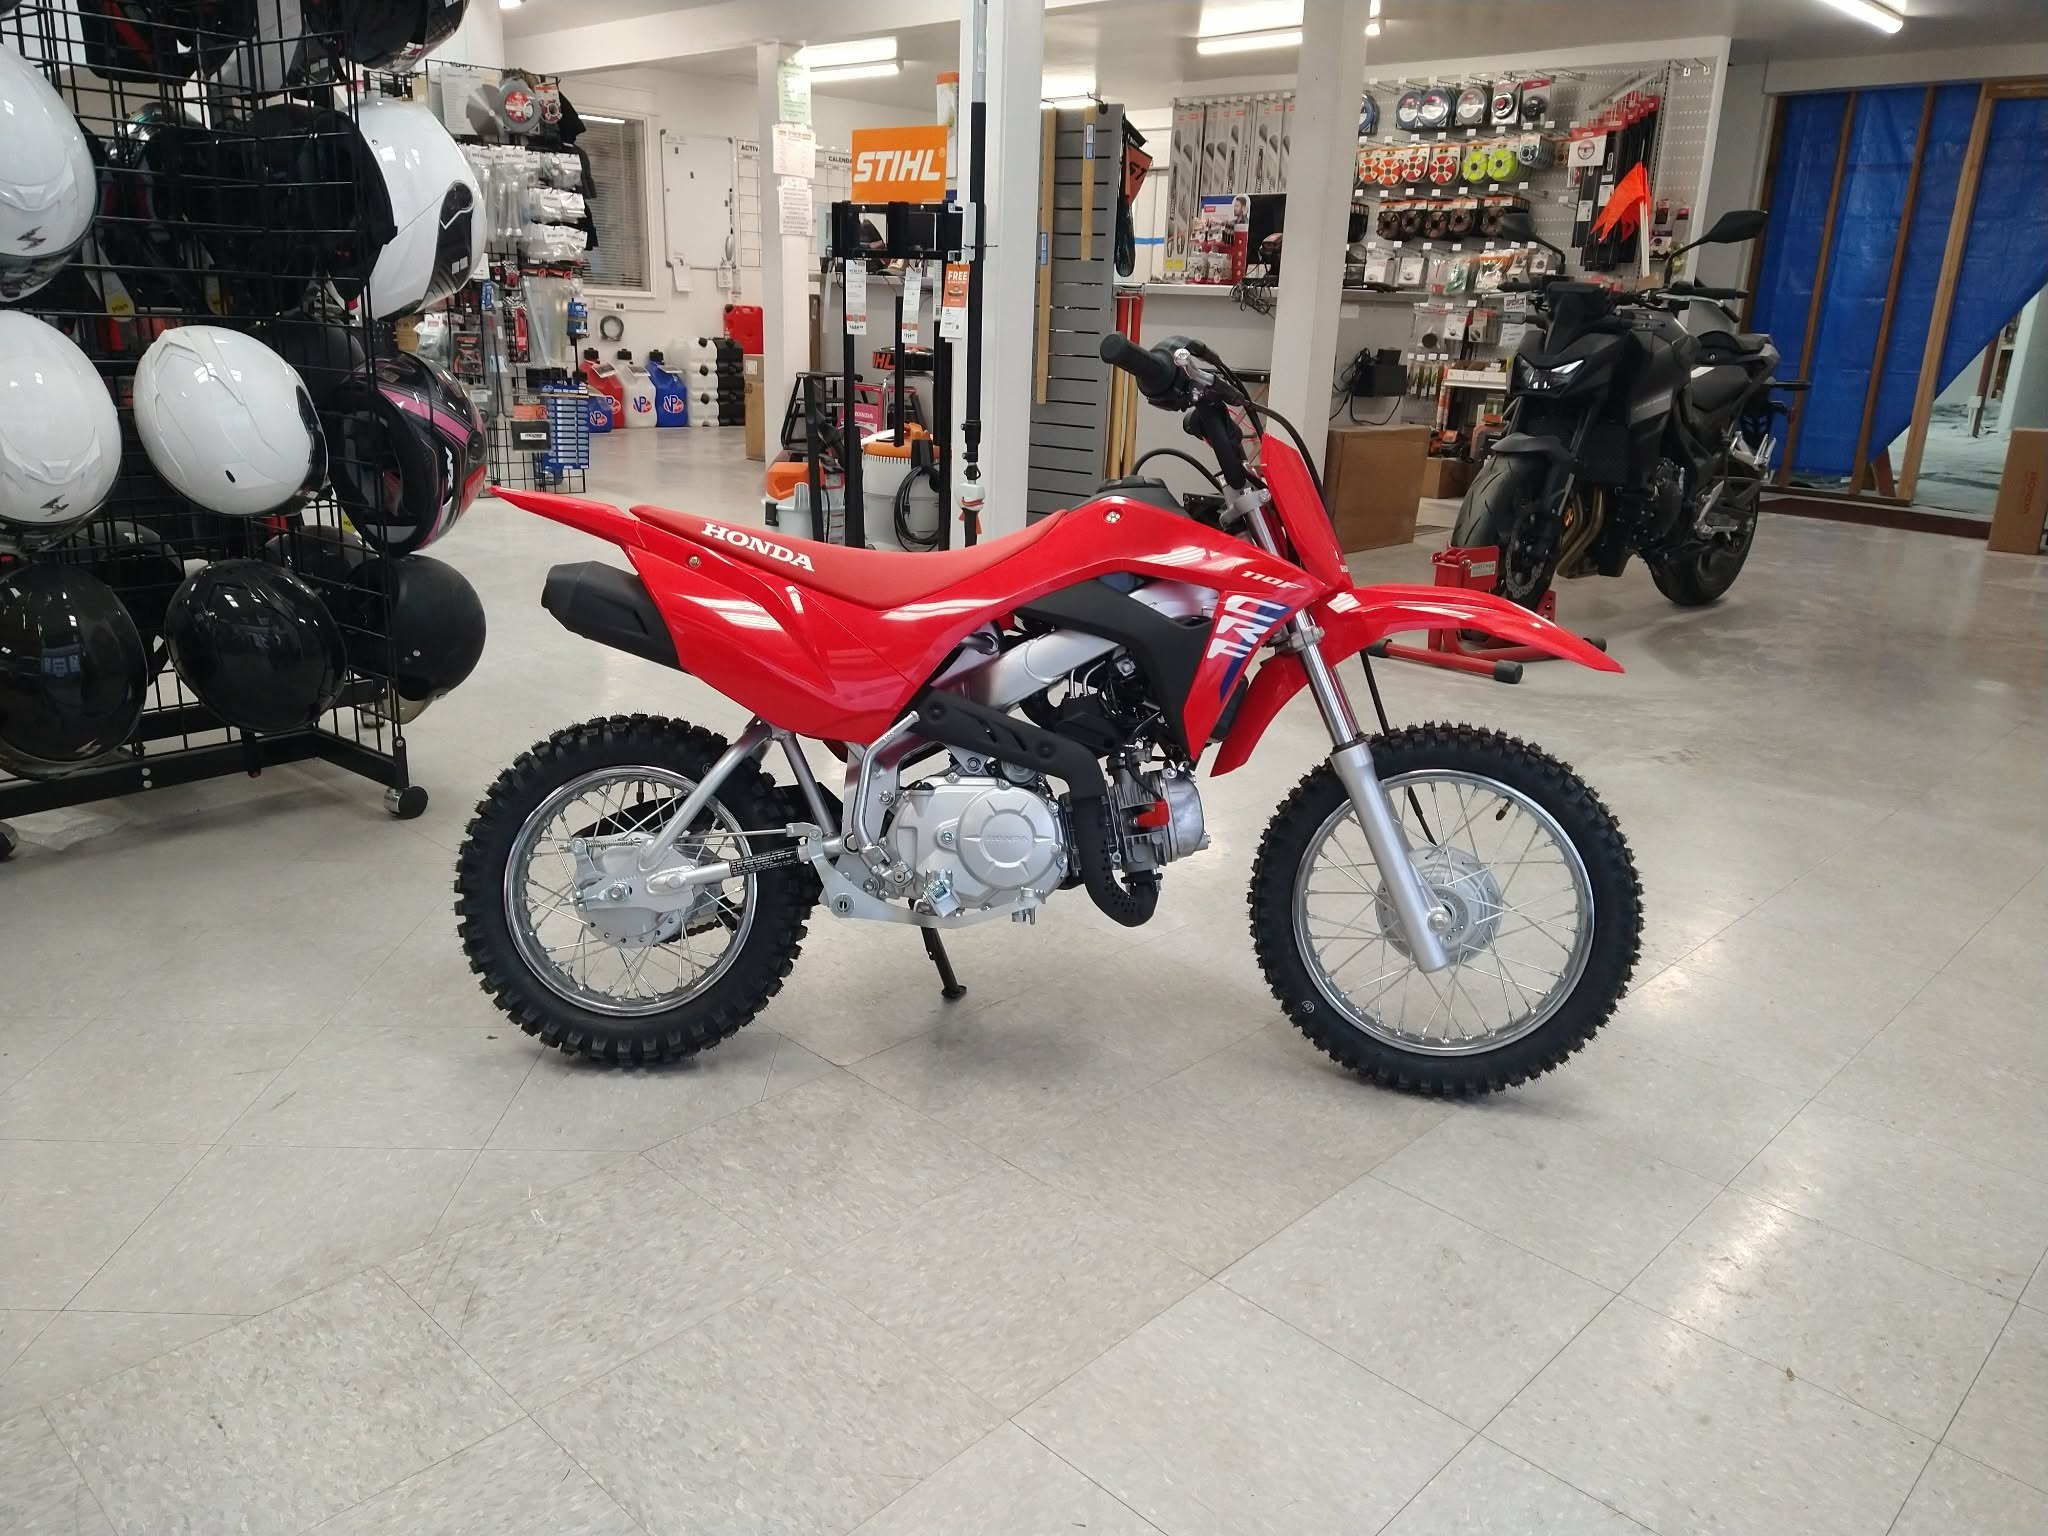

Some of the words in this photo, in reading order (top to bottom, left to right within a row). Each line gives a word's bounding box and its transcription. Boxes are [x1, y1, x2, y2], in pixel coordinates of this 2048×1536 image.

[854, 150, 941, 183] STIHL
[947, 271, 968, 281] FREE
[633, 396, 647, 413] VP
[664, 395, 679, 413] VP
[589, 411, 602, 425] VP
[701, 522, 815, 573] HONDA
[1241, 570, 1306, 589] 110F
